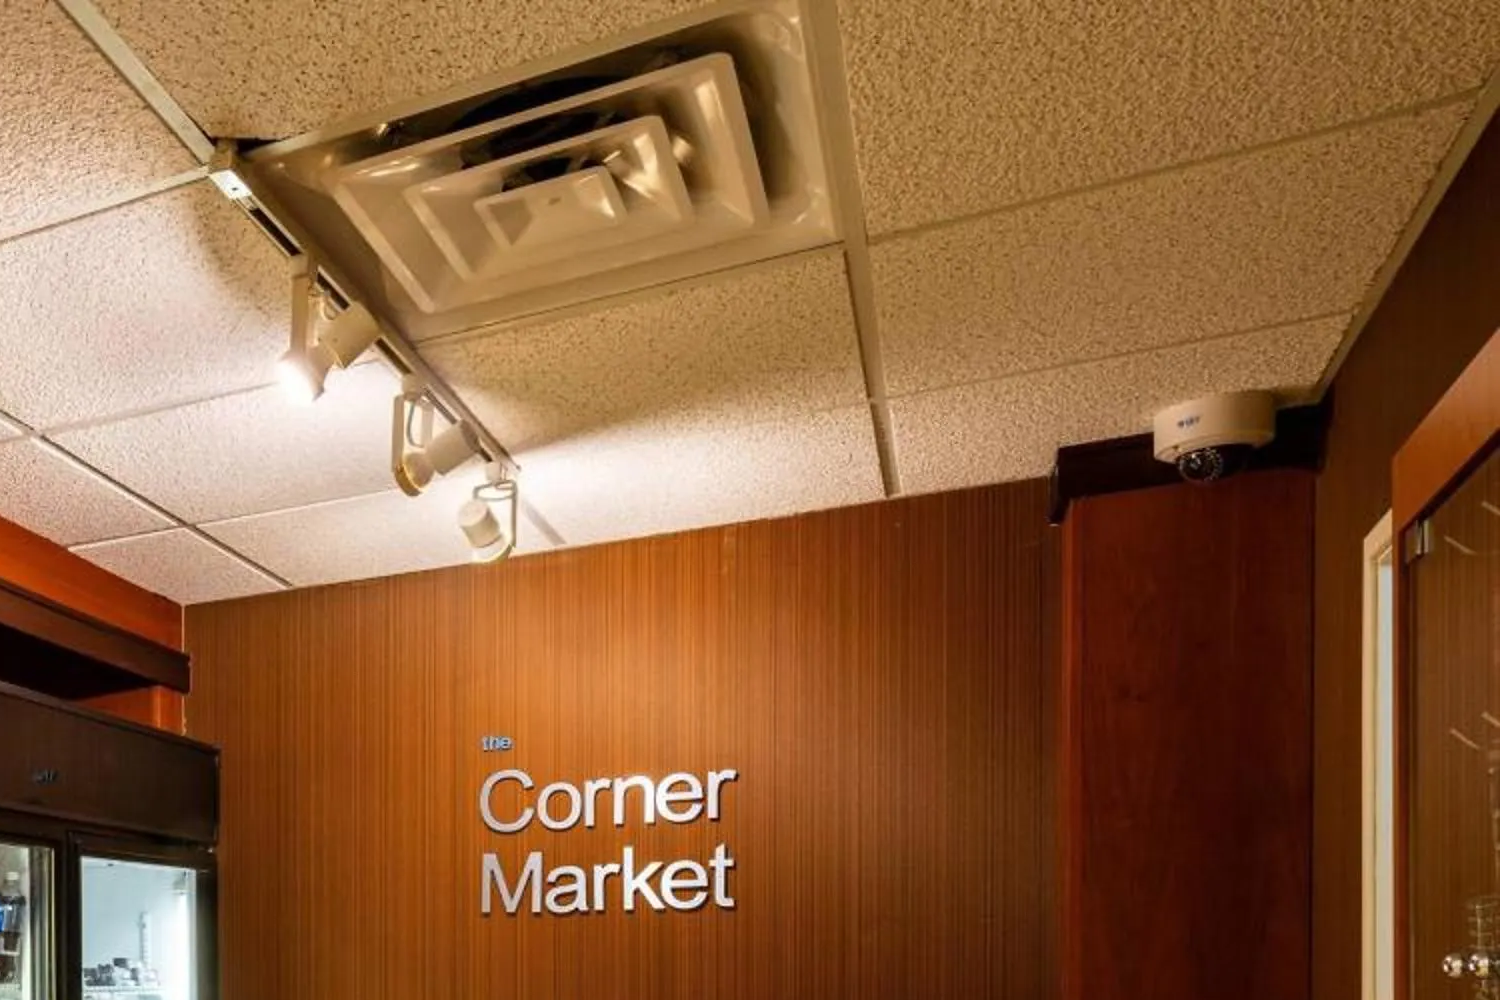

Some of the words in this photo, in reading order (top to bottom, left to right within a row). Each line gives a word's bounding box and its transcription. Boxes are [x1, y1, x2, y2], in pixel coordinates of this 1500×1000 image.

[482, 735, 512, 751] the
[479, 768, 738, 834] Corner
[480, 843, 736, 915] Market
